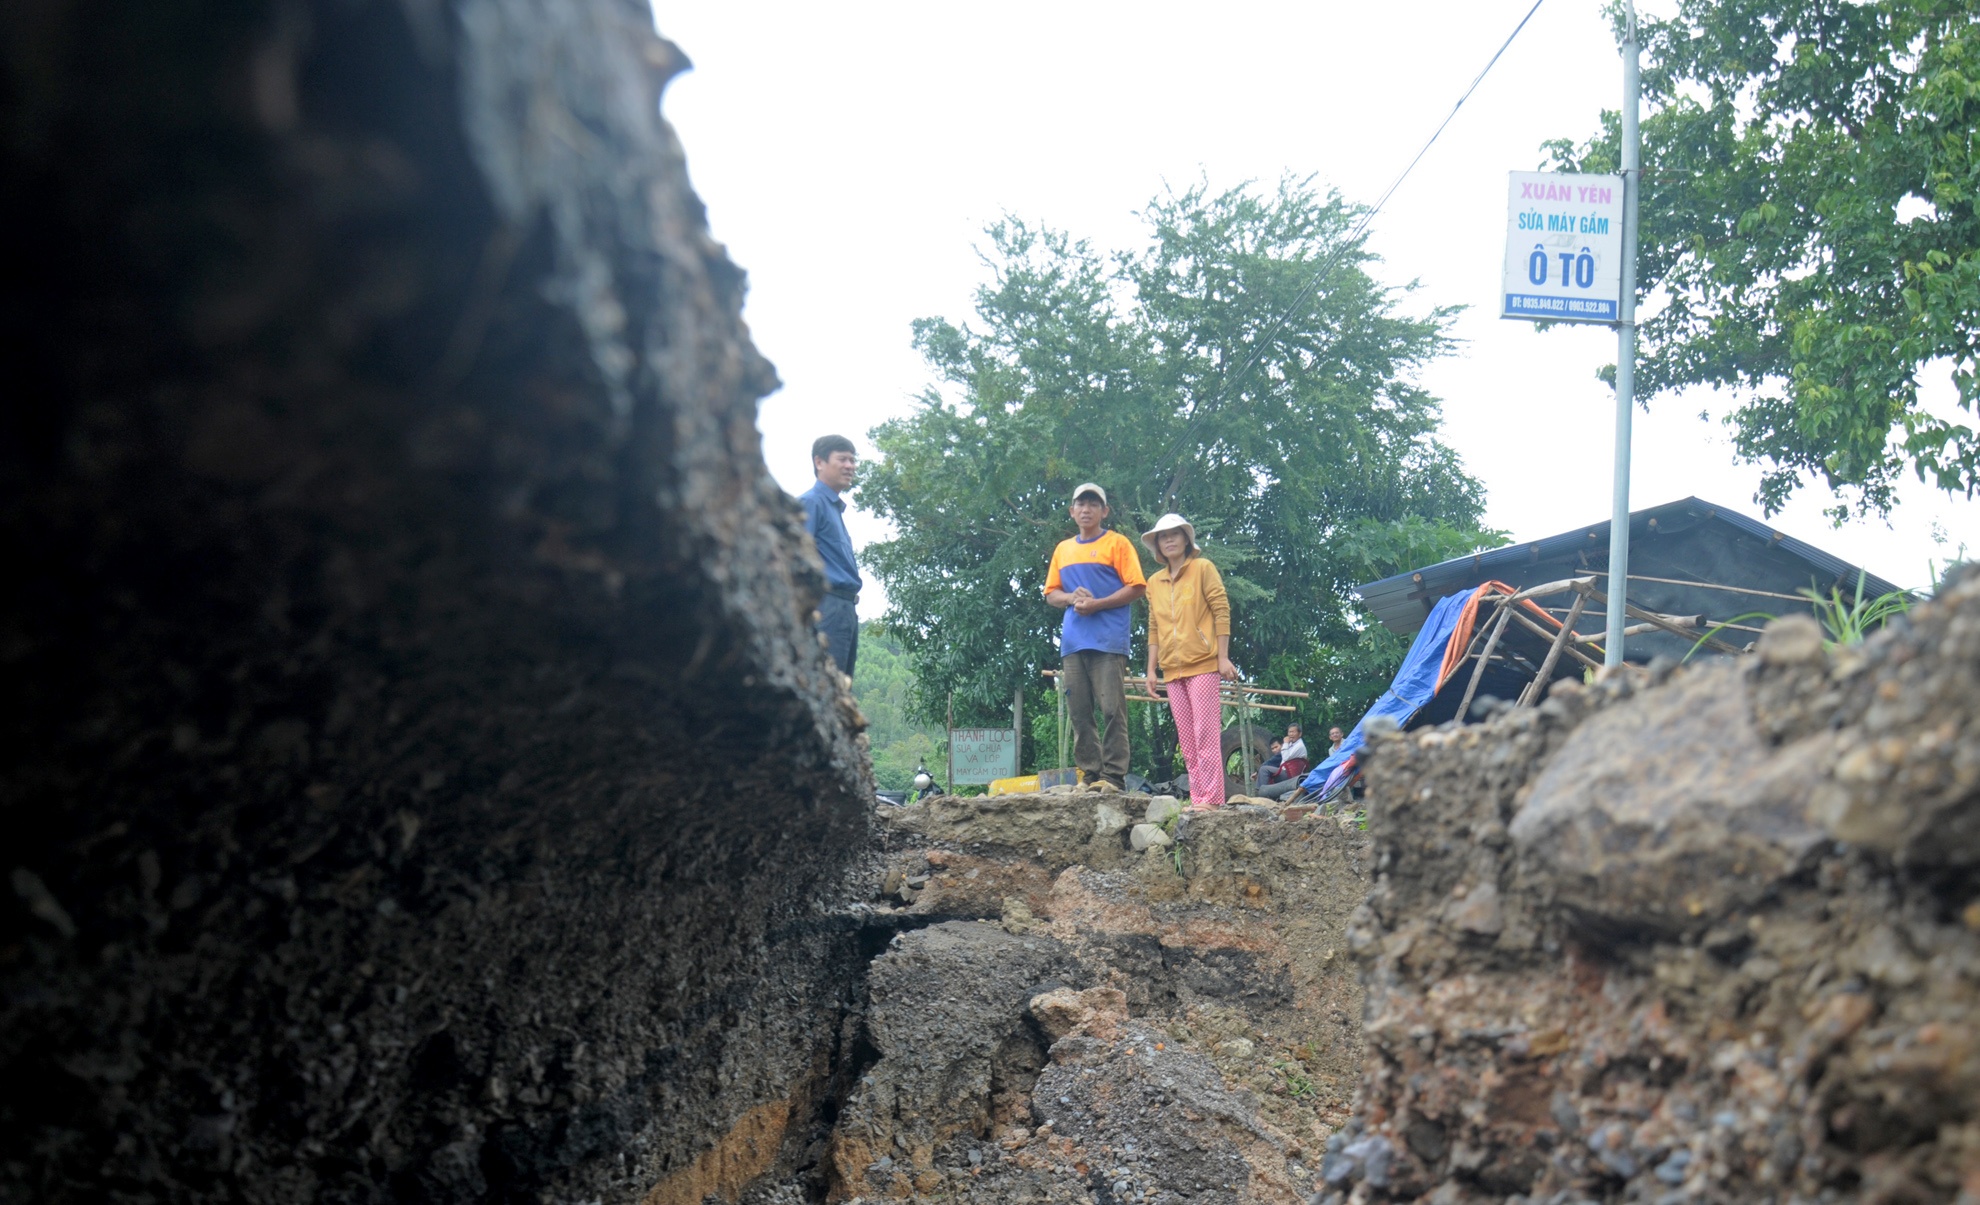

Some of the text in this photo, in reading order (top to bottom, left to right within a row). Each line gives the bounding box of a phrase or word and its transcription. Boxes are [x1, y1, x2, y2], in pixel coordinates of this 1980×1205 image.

[1520, 181, 1612, 204] XUÂN YÊN
[1518, 207, 1543, 231] SỬA
[1548, 212, 1576, 233] MÁY
[1528, 243, 1595, 289] Ô TÔ
